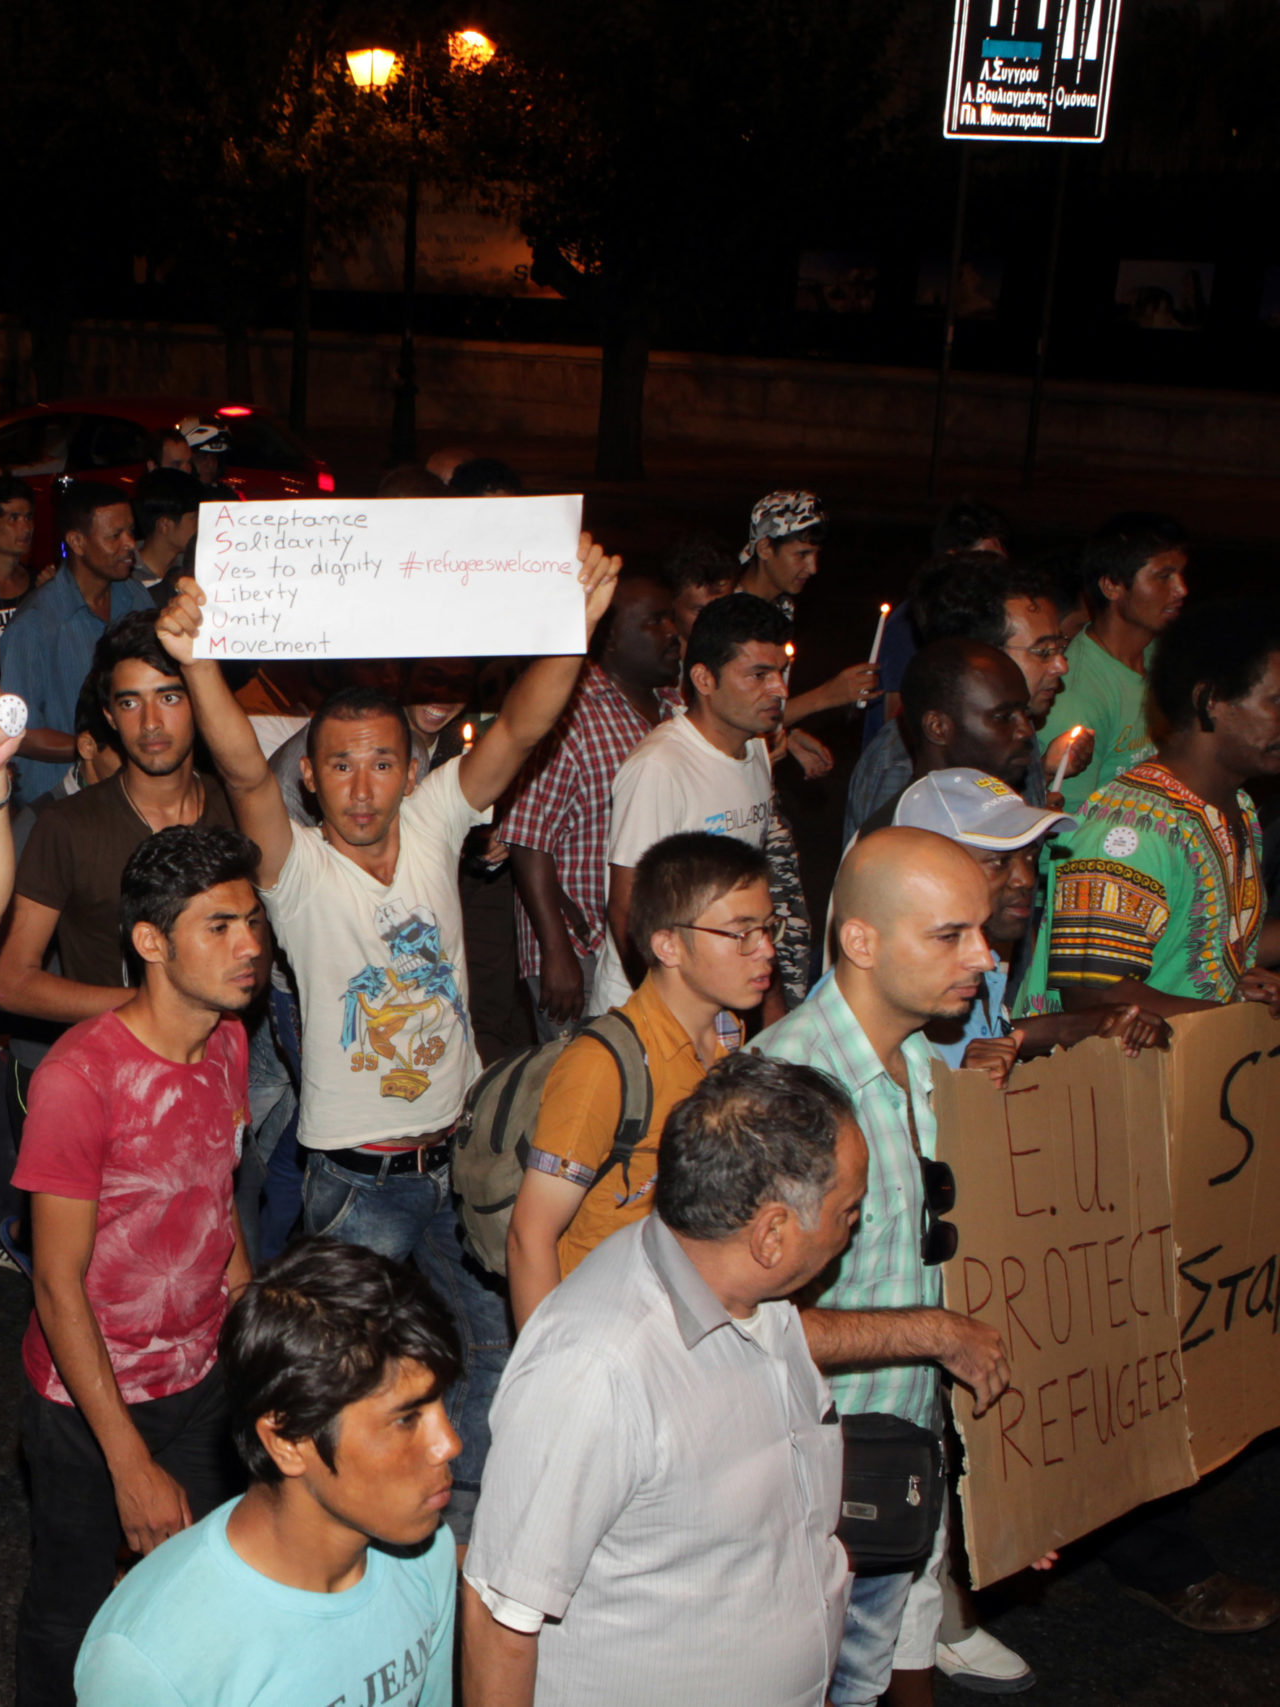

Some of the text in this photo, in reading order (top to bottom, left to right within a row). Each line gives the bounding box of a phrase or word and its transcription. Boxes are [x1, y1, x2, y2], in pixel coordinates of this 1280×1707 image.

[1055, 86, 1098, 110] Ομόνοια
[215, 506, 369, 531] Acceptance
[216, 531, 354, 561] Solidarity
[214, 550, 573, 587] Yes to dignity #refugeeswelcome
[214, 583, 299, 609] Liberty
[212, 611, 282, 633] Unity
[209, 631, 331, 655] Movement
[1003, 1083, 1116, 1218] E.U.
[962, 1224, 1173, 1362] PROTECT
[998, 1348, 1185, 1482] REFUGEES
